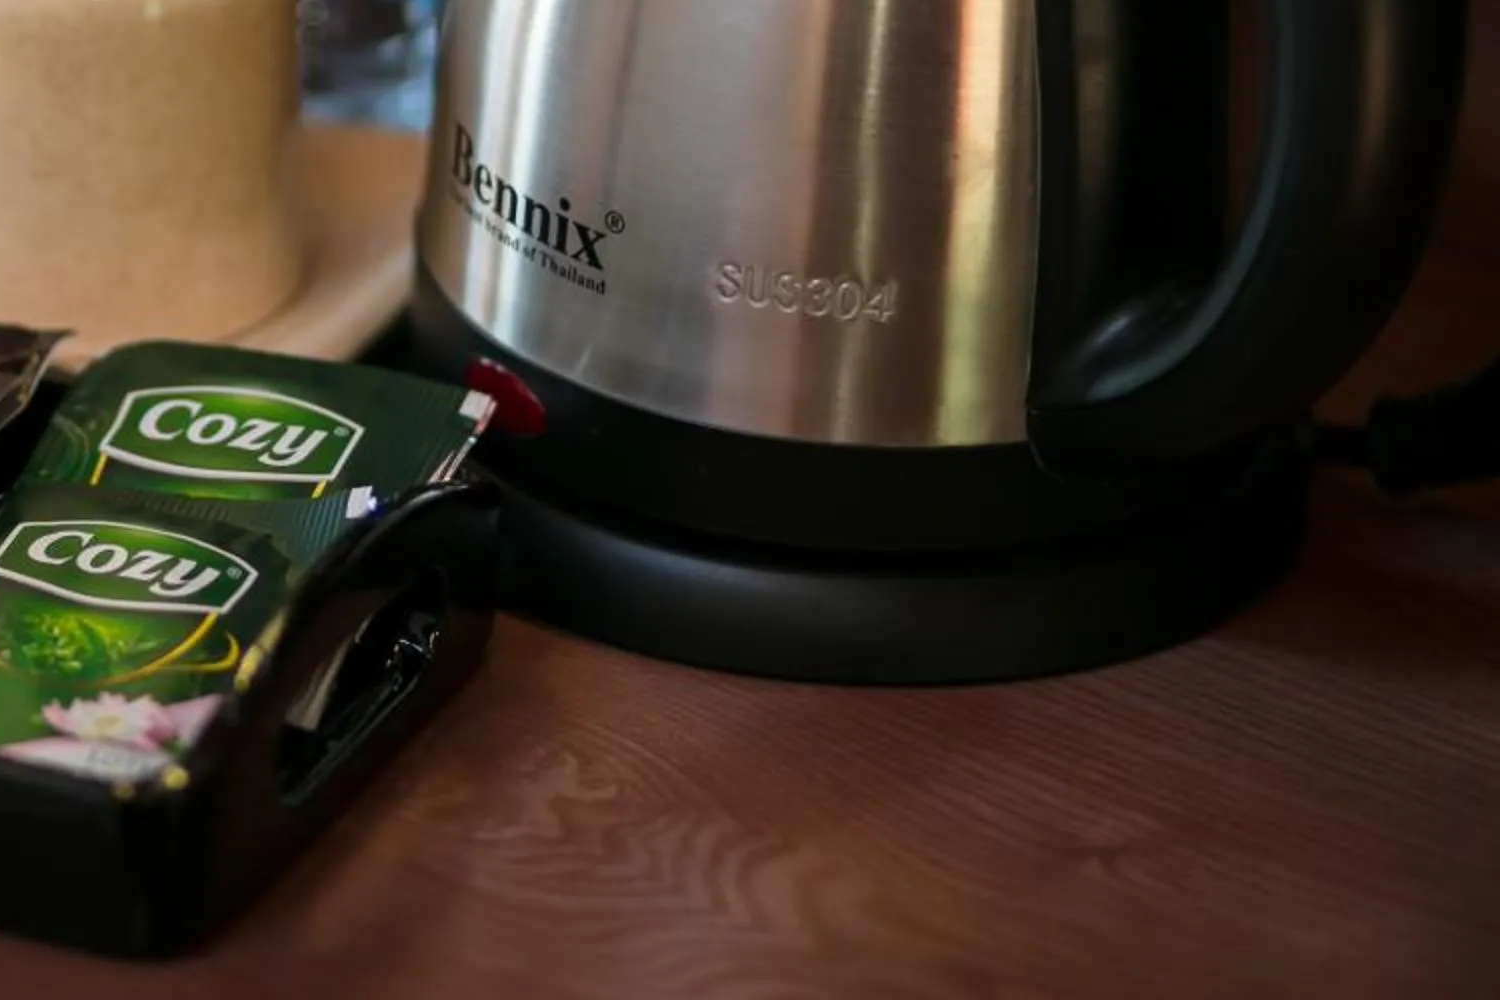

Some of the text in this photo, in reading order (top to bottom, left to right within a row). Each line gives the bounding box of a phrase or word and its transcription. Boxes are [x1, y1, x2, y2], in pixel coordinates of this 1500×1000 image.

[452, 123, 606, 271] Bennix
[539, 251, 607, 295] Thailand
[716, 261, 898, 323] SUS304
[138, 398, 329, 467] Cozy
[27, 529, 222, 598] Cozy
